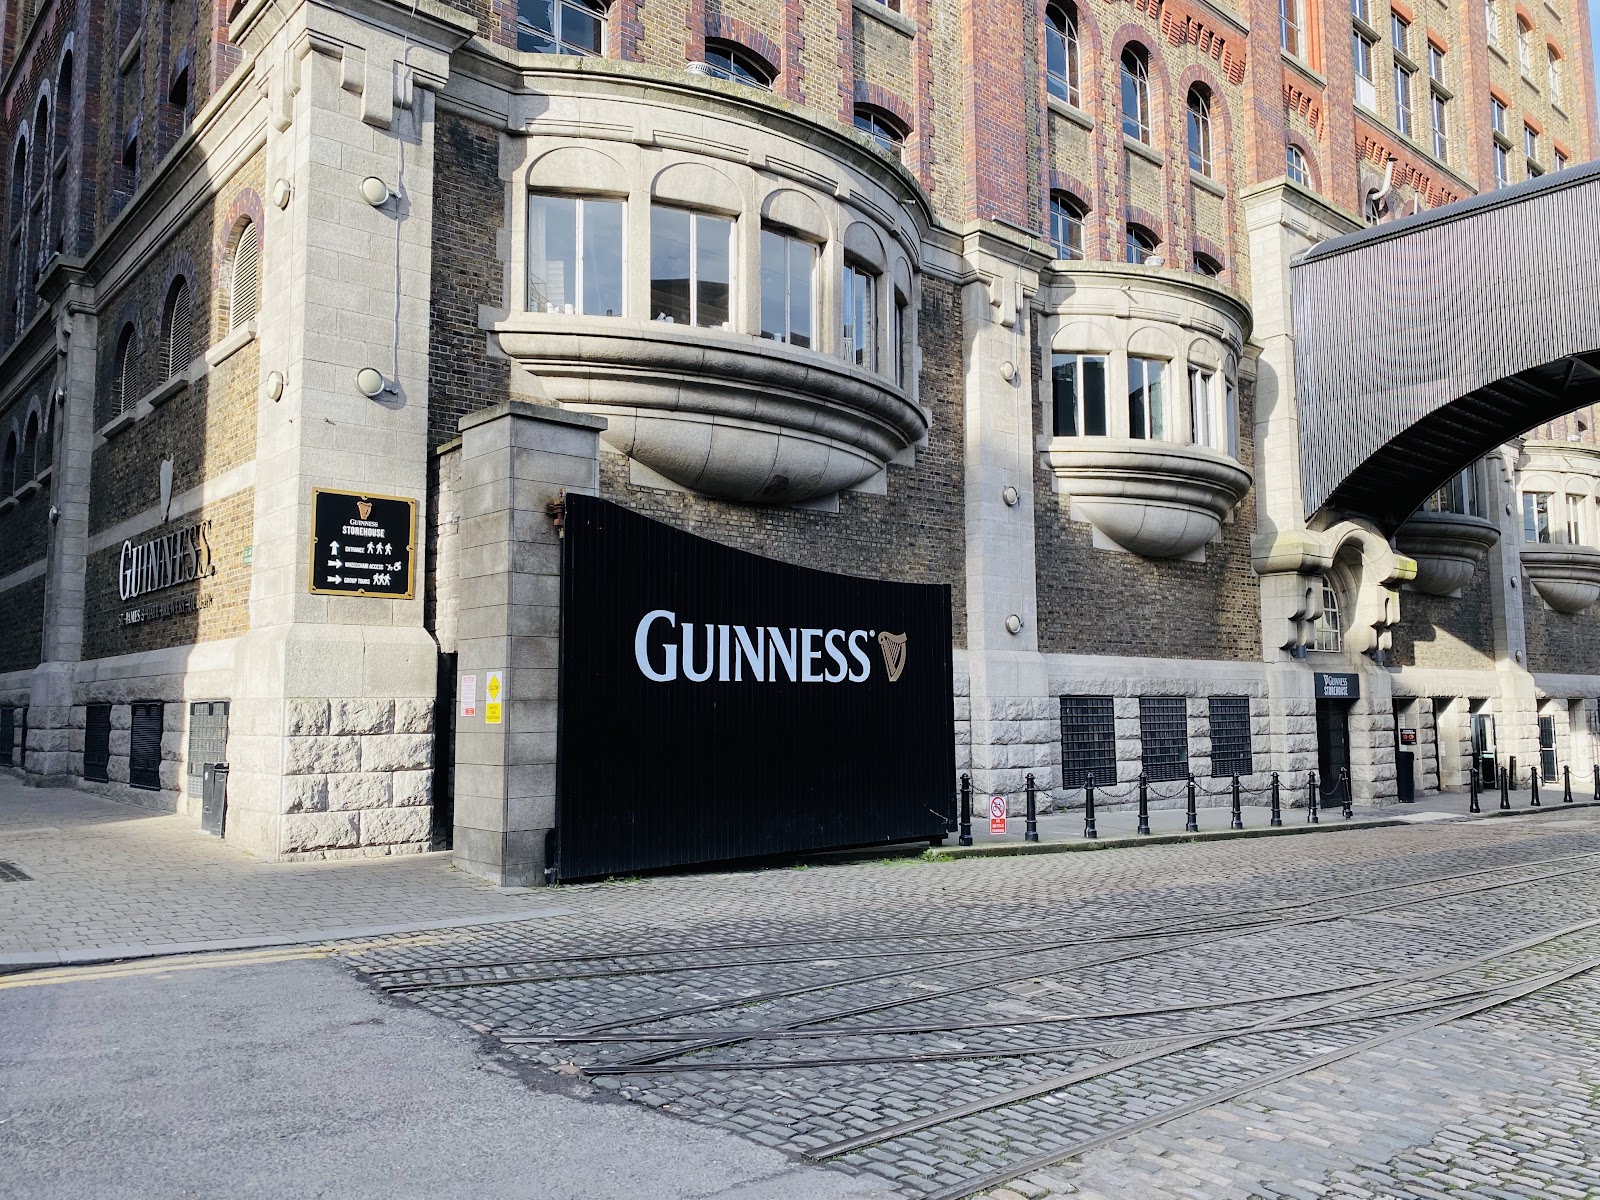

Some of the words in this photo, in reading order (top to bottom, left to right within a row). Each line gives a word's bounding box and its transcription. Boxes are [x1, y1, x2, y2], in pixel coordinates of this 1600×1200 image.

[349, 518, 379, 527] GUINNESS
[342, 525, 385, 538] STOREHOUSE
[344, 546, 365, 554] ENTRANCE
[119, 520, 212, 601] GUINNESS
[368, 563, 384, 571] ACCESS
[357, 577, 371, 585] TOURS
[634, 609, 871, 683] GUINNESS
[1328, 675, 1348, 686] GUINNESS
[1323, 686, 1349, 696] STOREHOUSE
